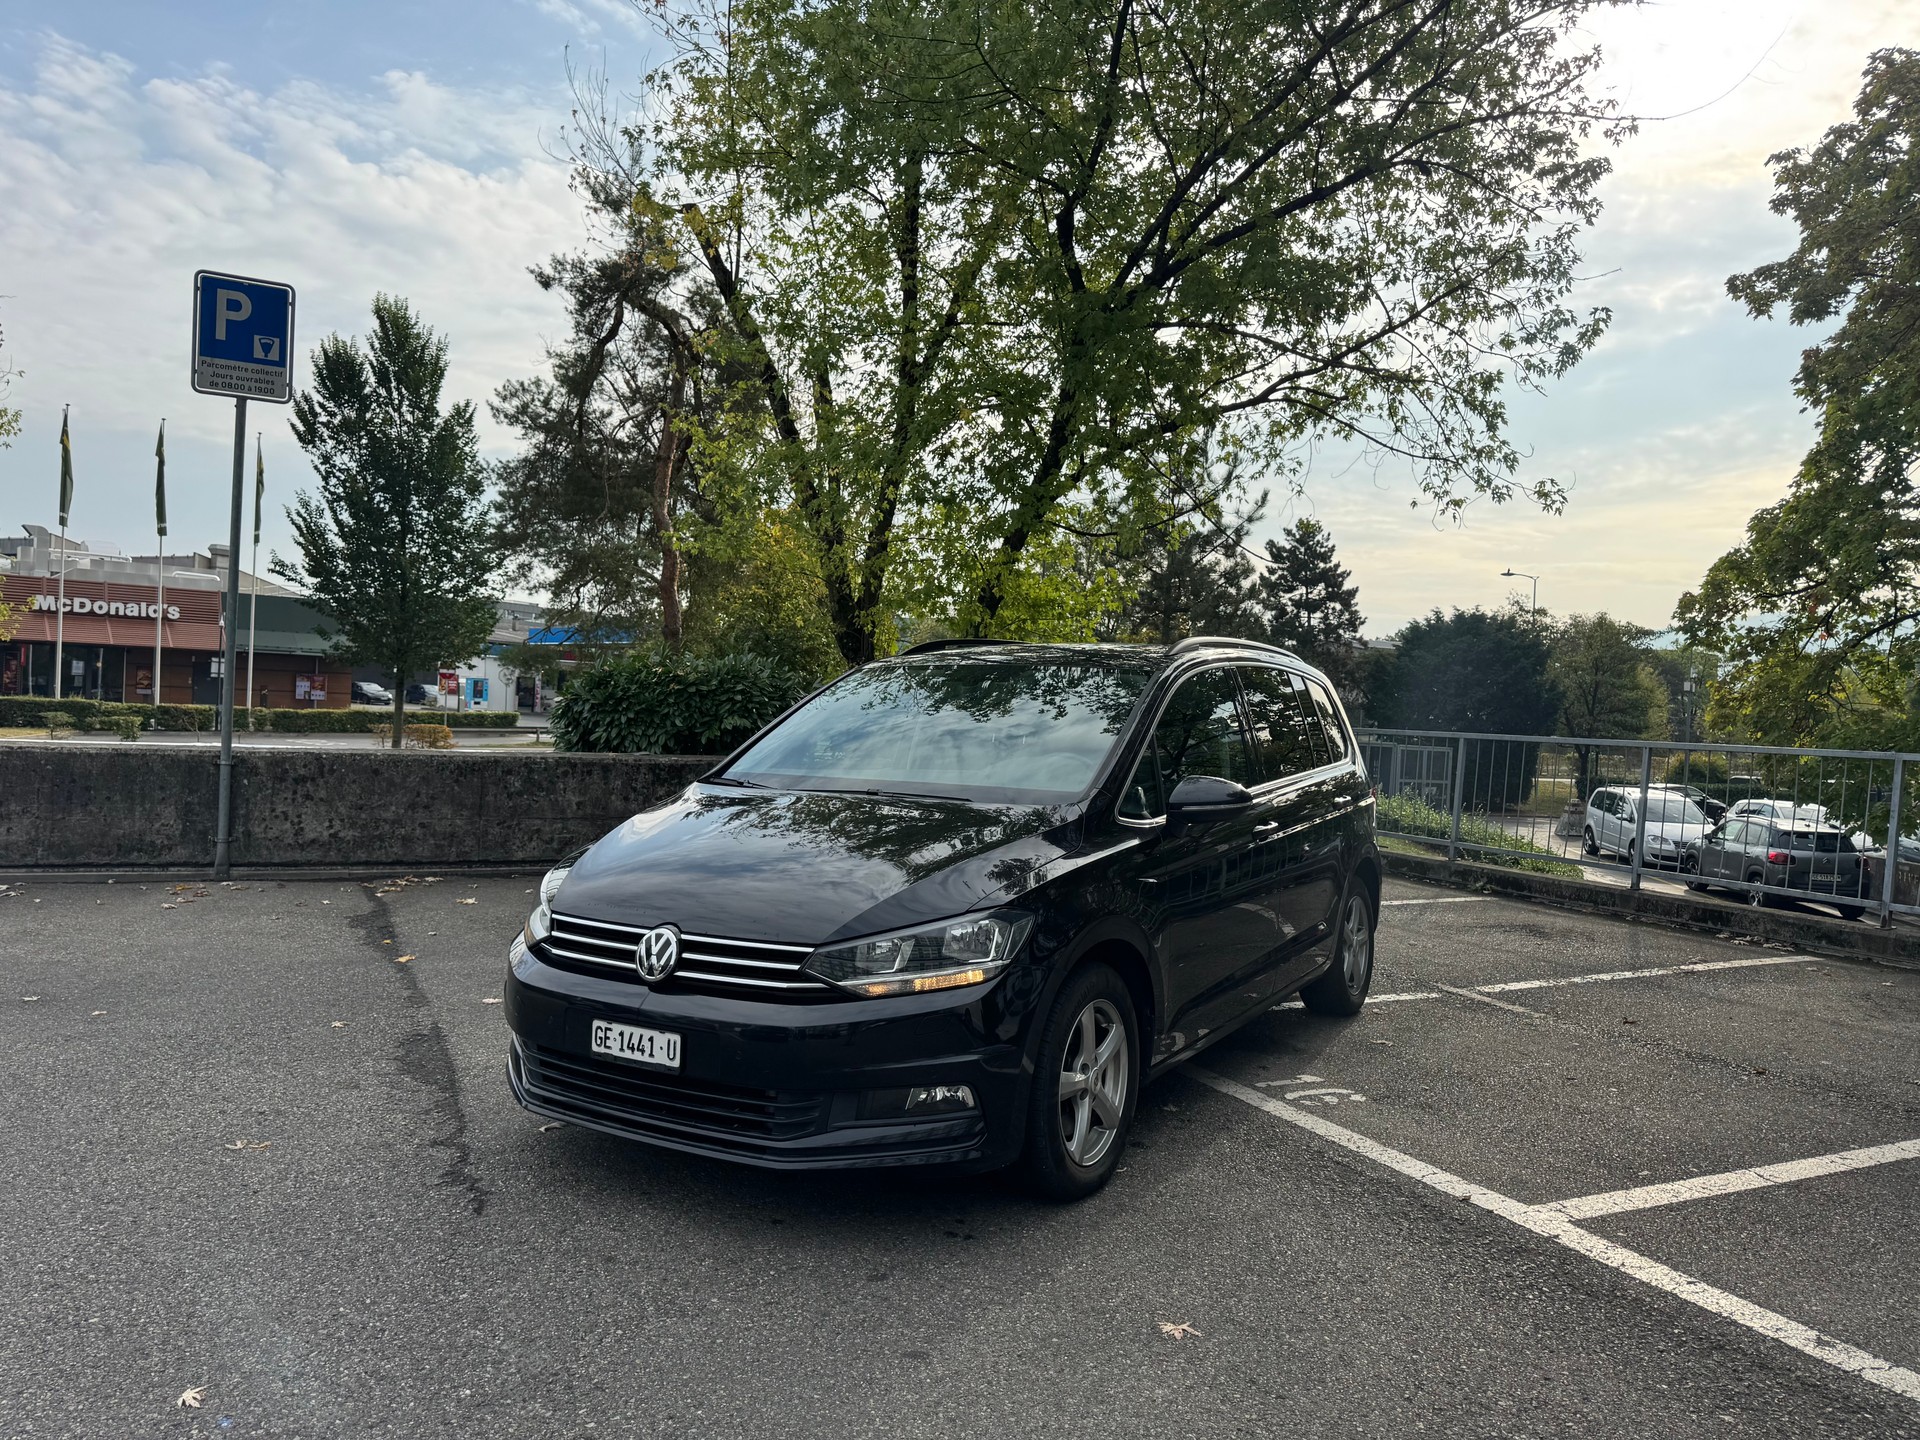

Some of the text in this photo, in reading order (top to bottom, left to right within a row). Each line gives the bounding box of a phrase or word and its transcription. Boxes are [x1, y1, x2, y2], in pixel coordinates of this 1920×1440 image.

[215, 288, 252, 341] P
[201, 360, 283, 378] Parcomètre collectif
[209, 380, 220, 388] de
[210, 371, 275, 386] Jours ouvrables
[35, 594, 181, 620] McDonald's
